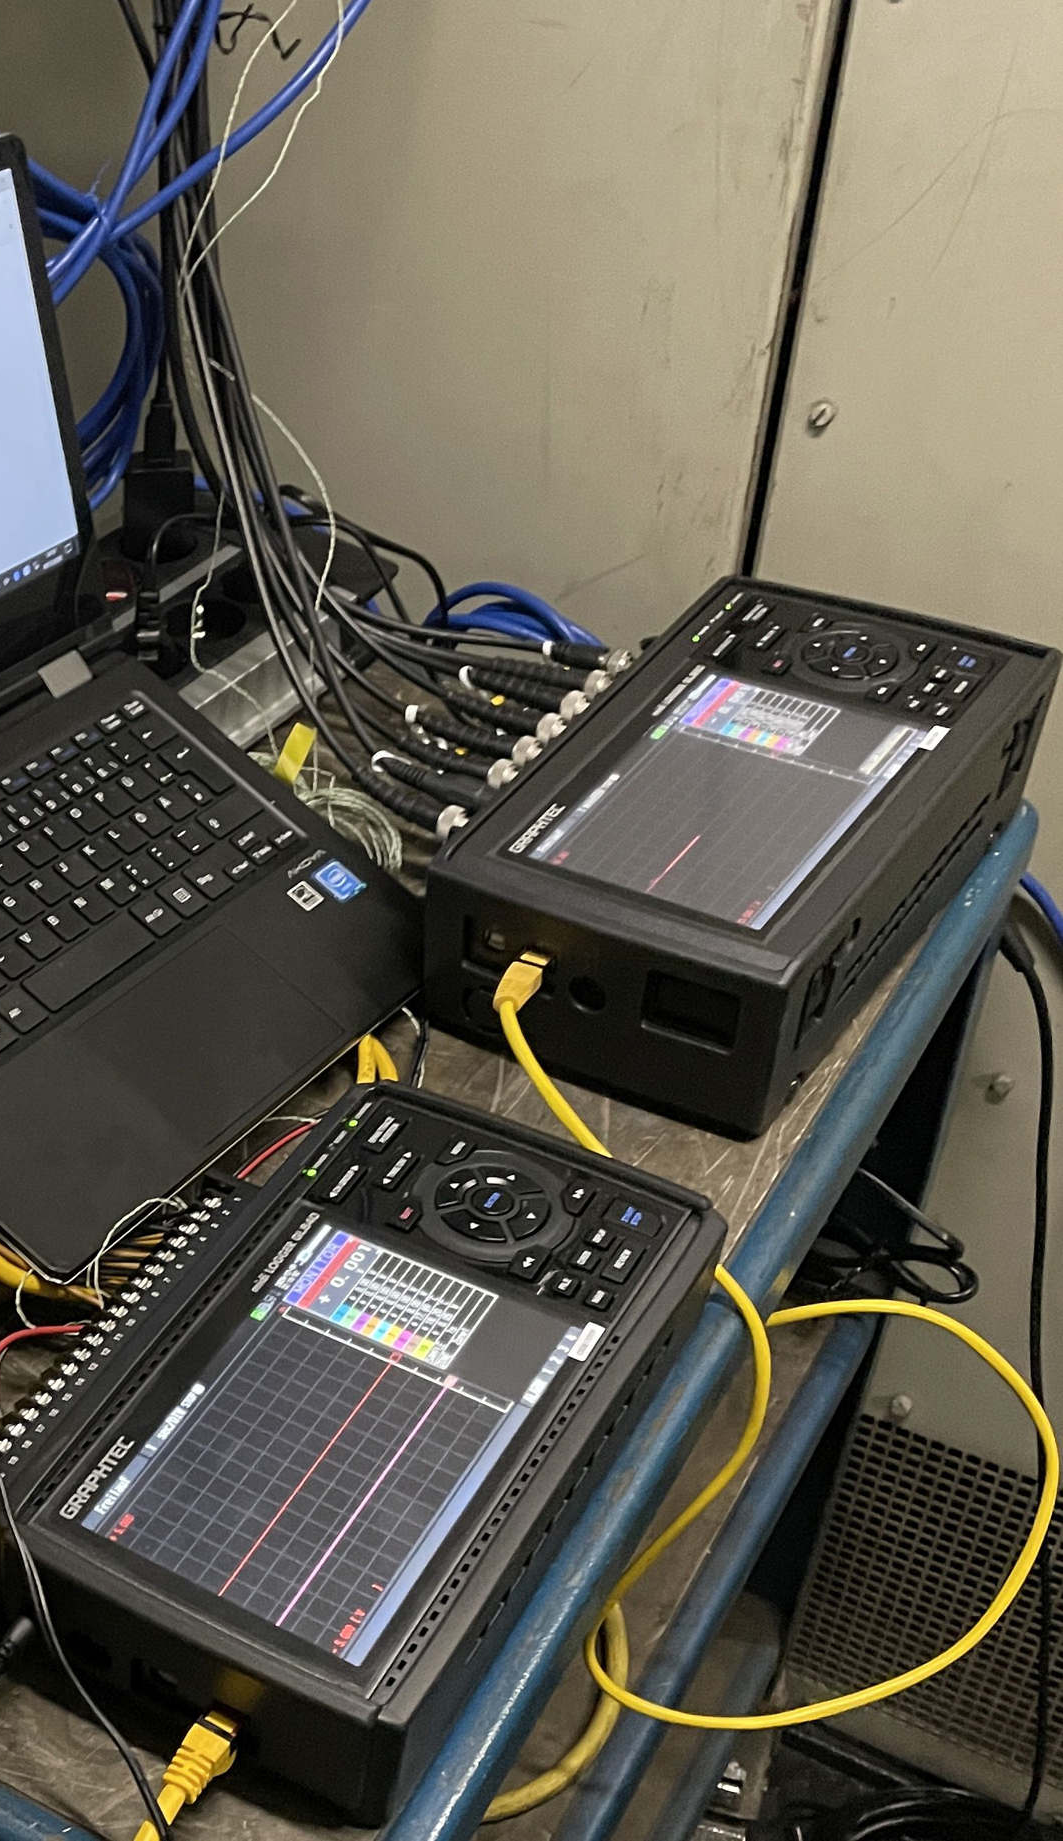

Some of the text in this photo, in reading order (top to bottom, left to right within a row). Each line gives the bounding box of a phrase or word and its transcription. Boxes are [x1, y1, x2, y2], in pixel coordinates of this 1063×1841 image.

[107, 830, 121, 839] L
[82, 844, 96, 856] K
[2, 896, 16, 907] G
[18, 932, 32, 944] V
[265, 1240, 297, 1275] LOGGER
[293, 1242, 340, 1295] MONITOR
[59, 1435, 135, 1520] GRAPHTEC
[93, 1474, 131, 1515] Freilauf
